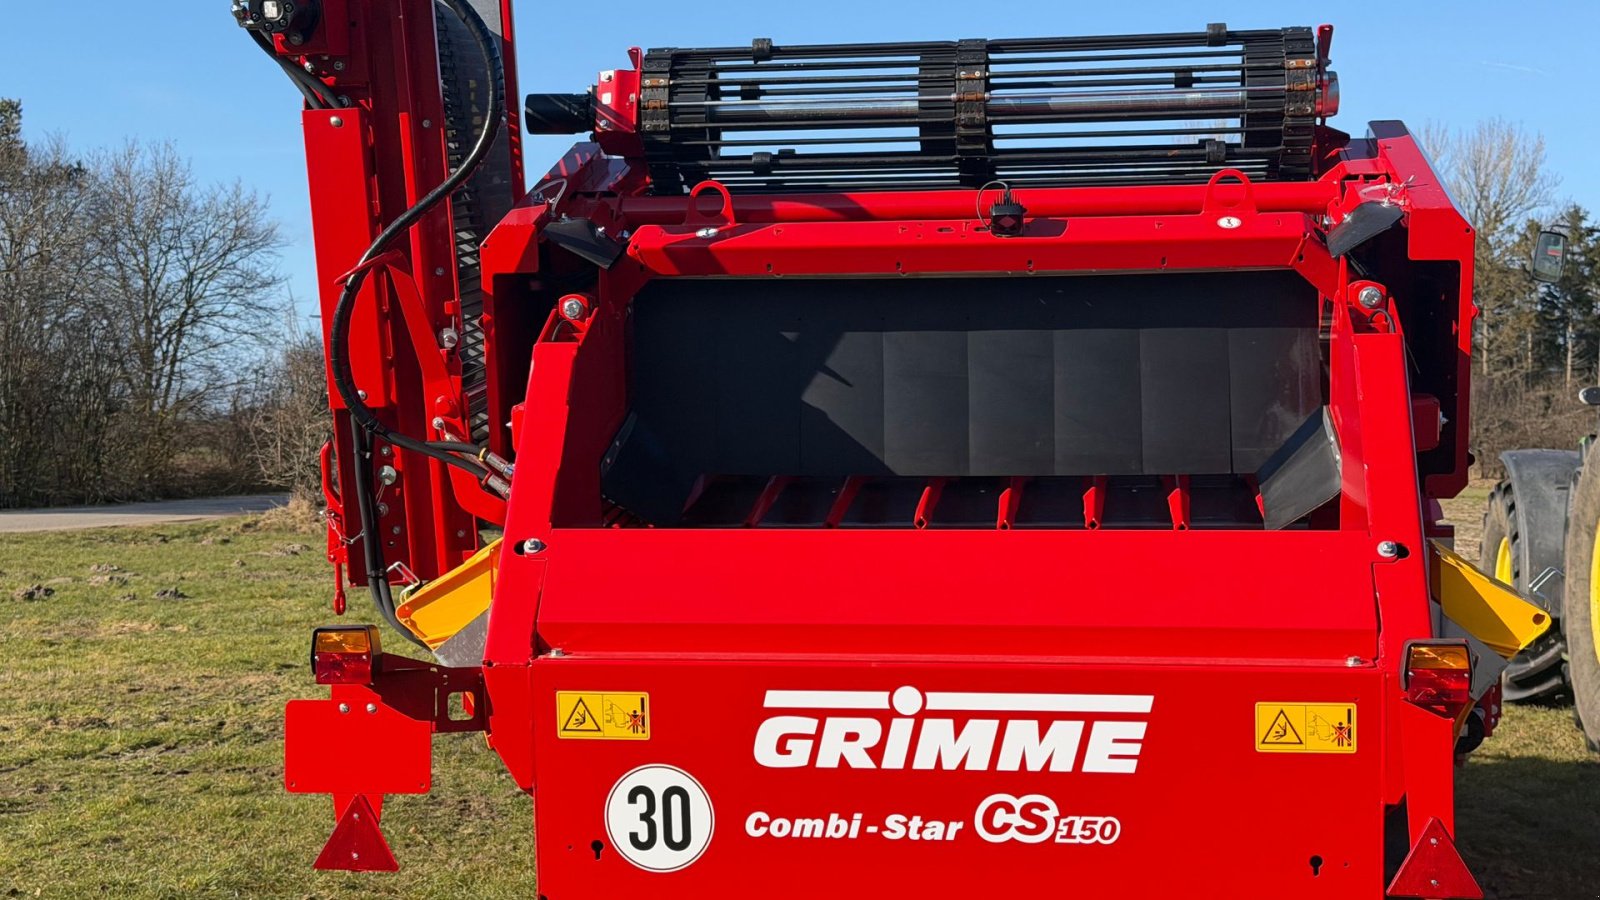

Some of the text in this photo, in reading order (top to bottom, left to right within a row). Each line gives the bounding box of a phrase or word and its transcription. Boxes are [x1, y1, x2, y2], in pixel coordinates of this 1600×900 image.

[628, 786, 692, 851] 30
[977, 796, 1057, 842] CS
[1056, 817, 1119, 843] 150
